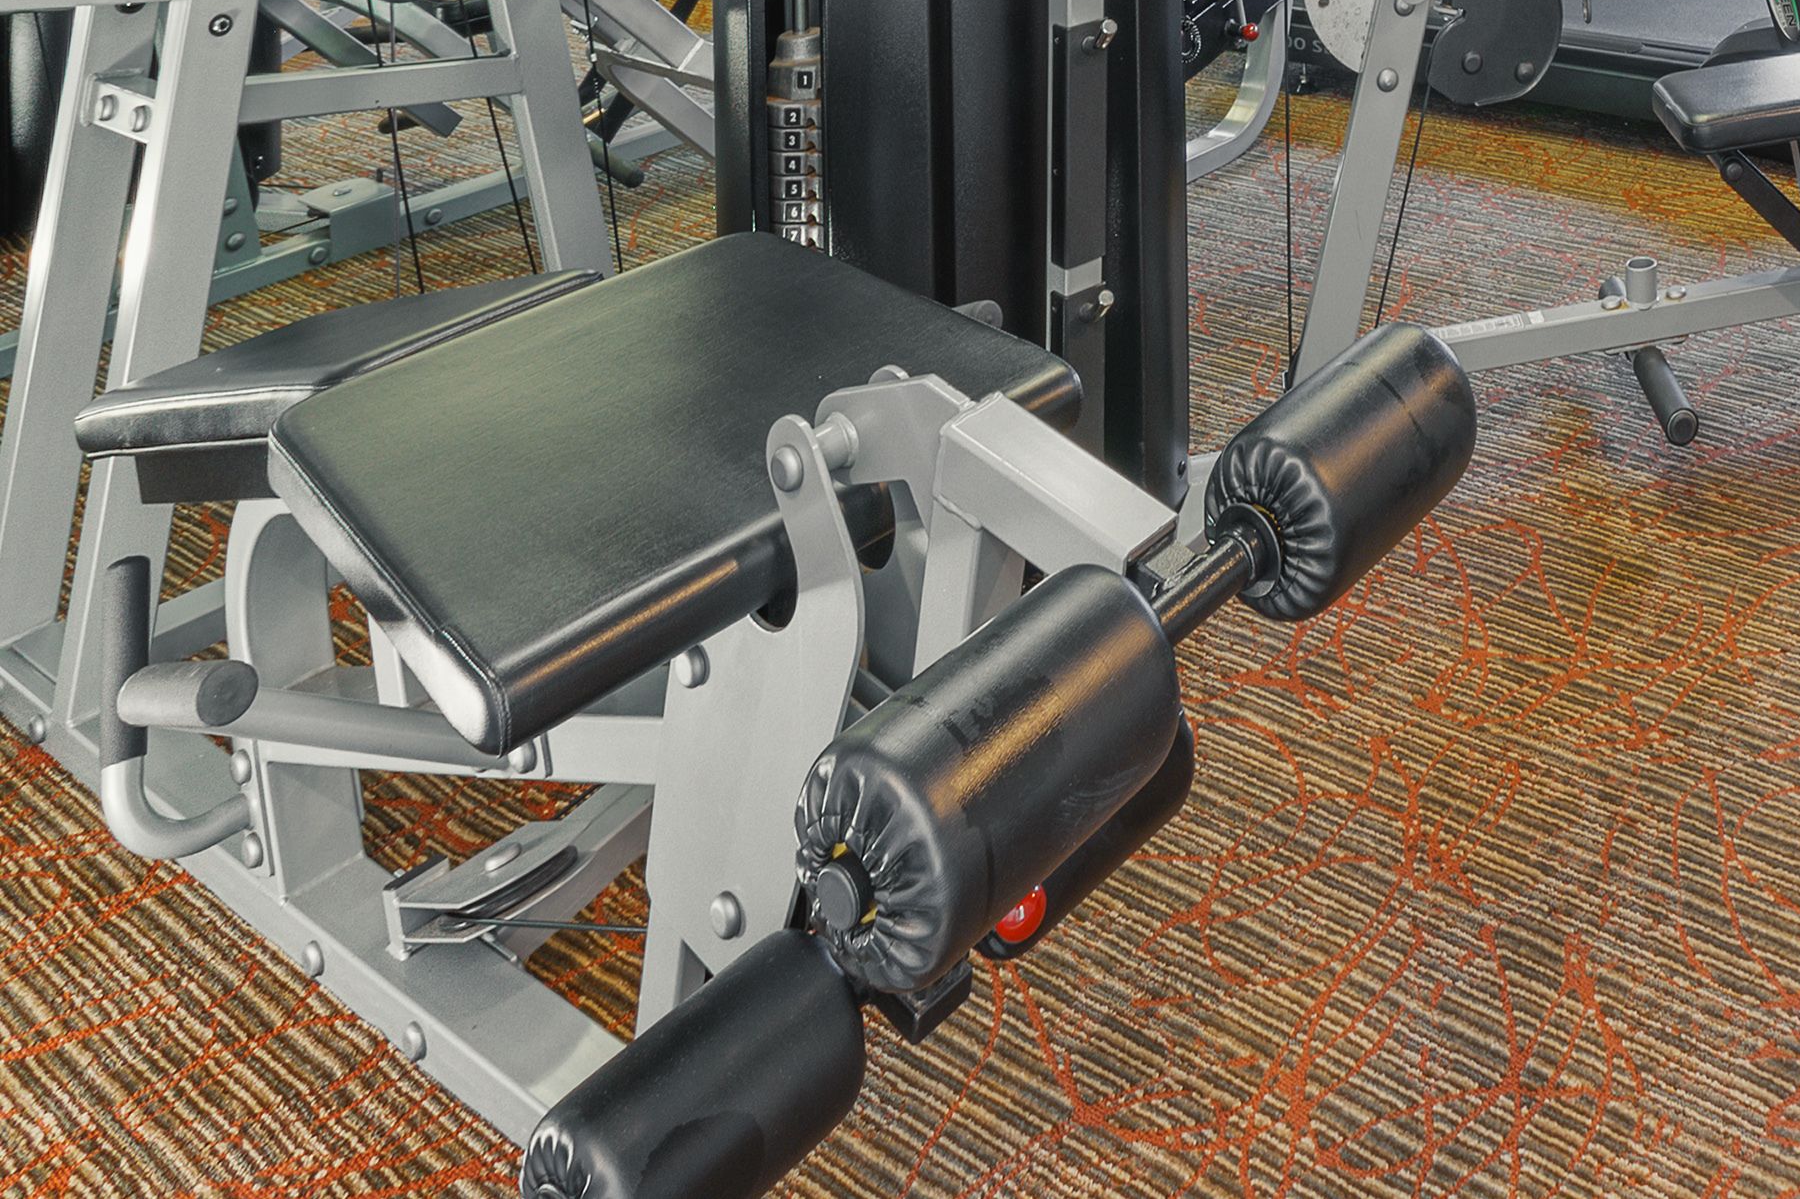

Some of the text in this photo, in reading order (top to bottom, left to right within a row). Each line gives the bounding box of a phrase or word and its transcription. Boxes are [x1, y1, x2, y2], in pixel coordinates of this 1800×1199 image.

[802, 75, 809, 86] 1
[789, 111, 797, 123] 2
[788, 135, 796, 146] 3
[788, 159, 796, 170] 4
[790, 183, 798, 195] 5
[790, 206, 798, 218] 6
[790, 230, 798, 242] 7
